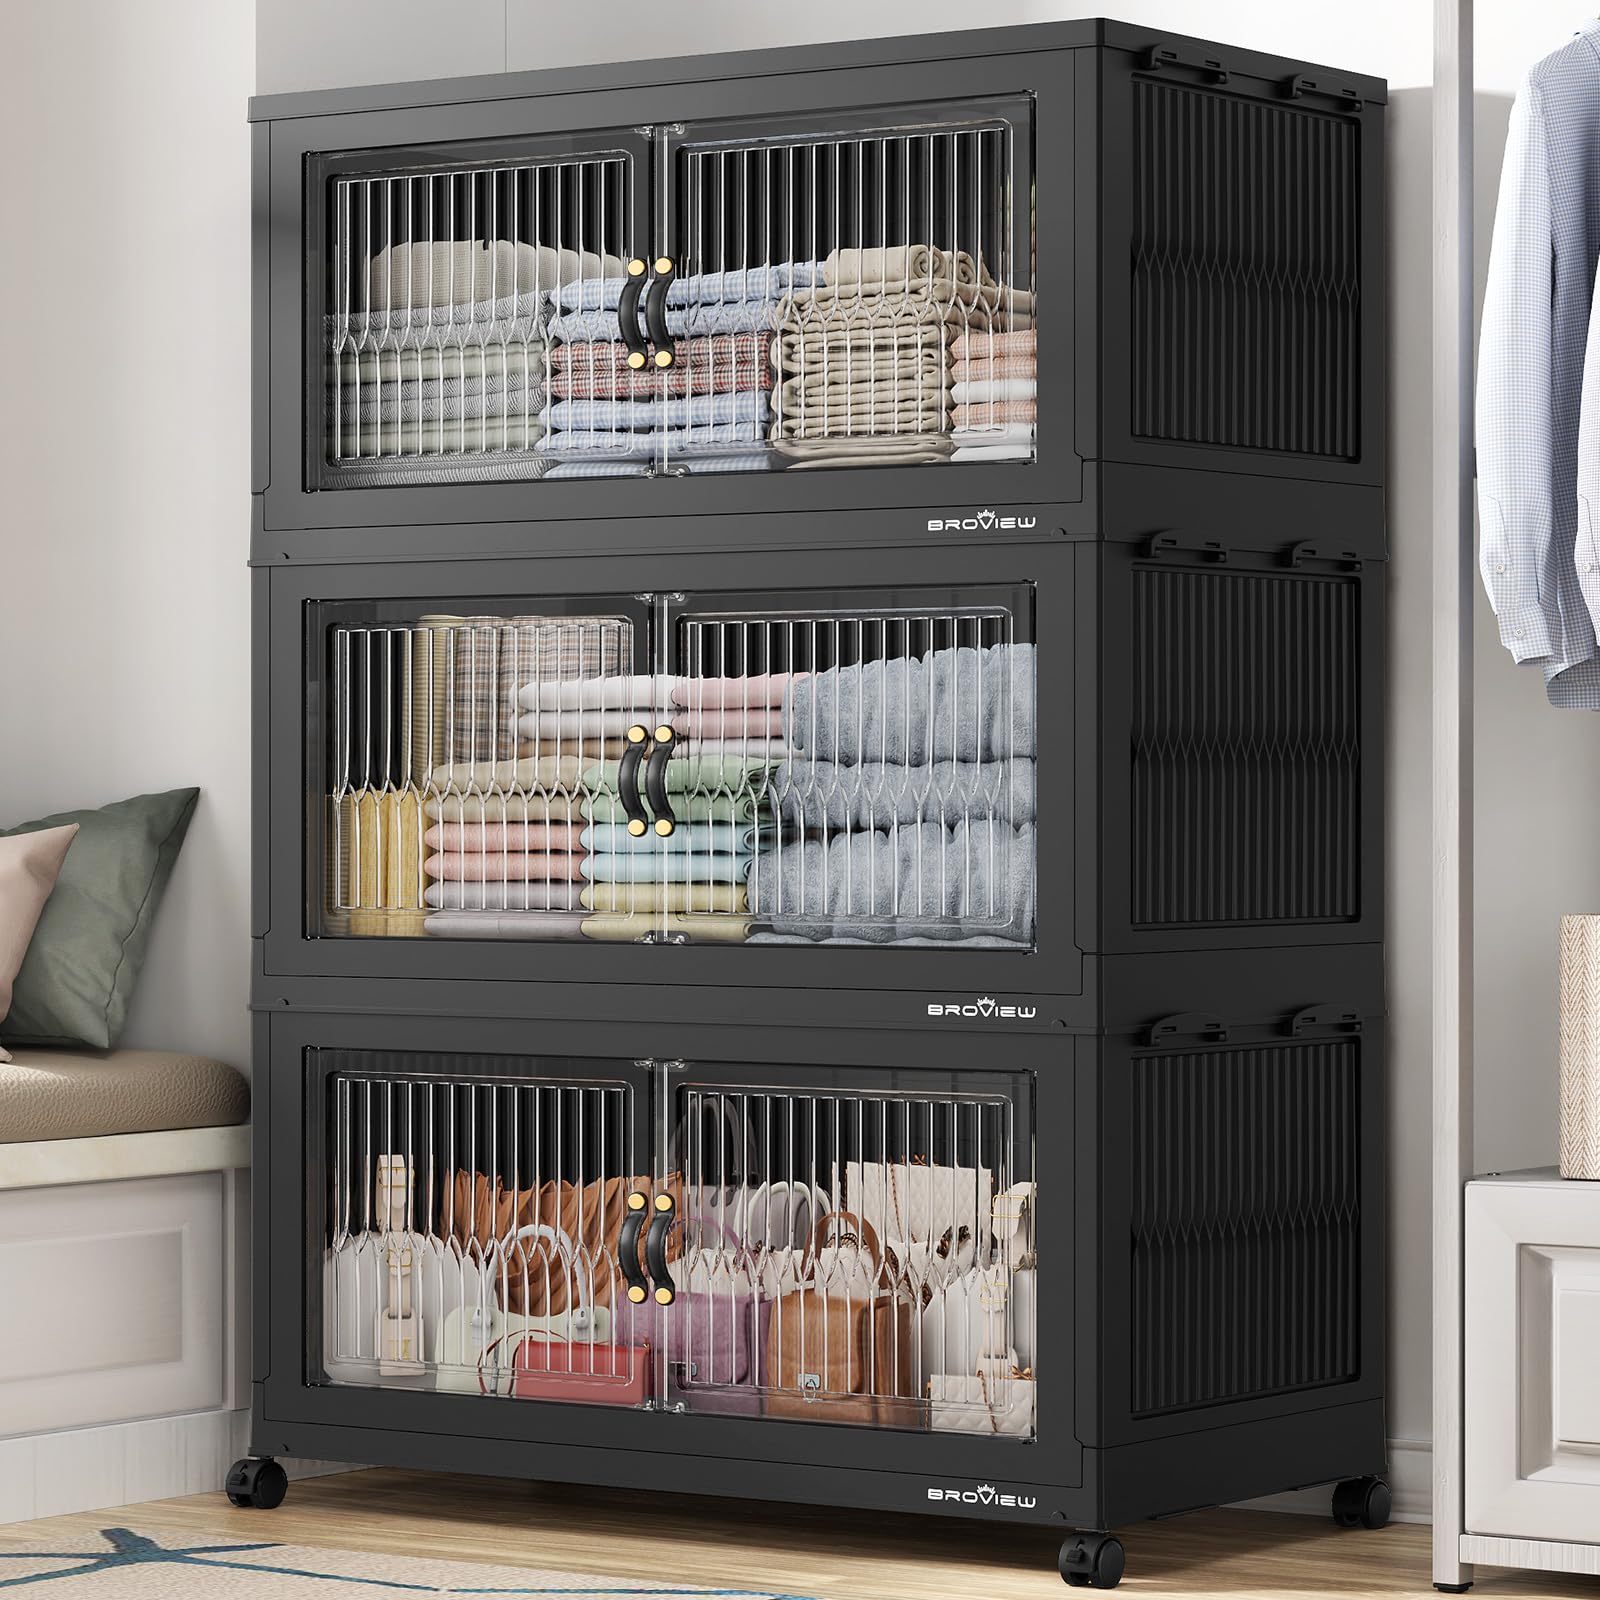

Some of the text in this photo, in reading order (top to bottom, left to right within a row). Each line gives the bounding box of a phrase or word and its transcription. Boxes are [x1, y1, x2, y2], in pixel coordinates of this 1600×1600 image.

[927, 511, 1037, 532] BROVIEW
[927, 998, 1037, 1019] BROVIEW
[927, 1485, 1037, 1509] BROVIEW
